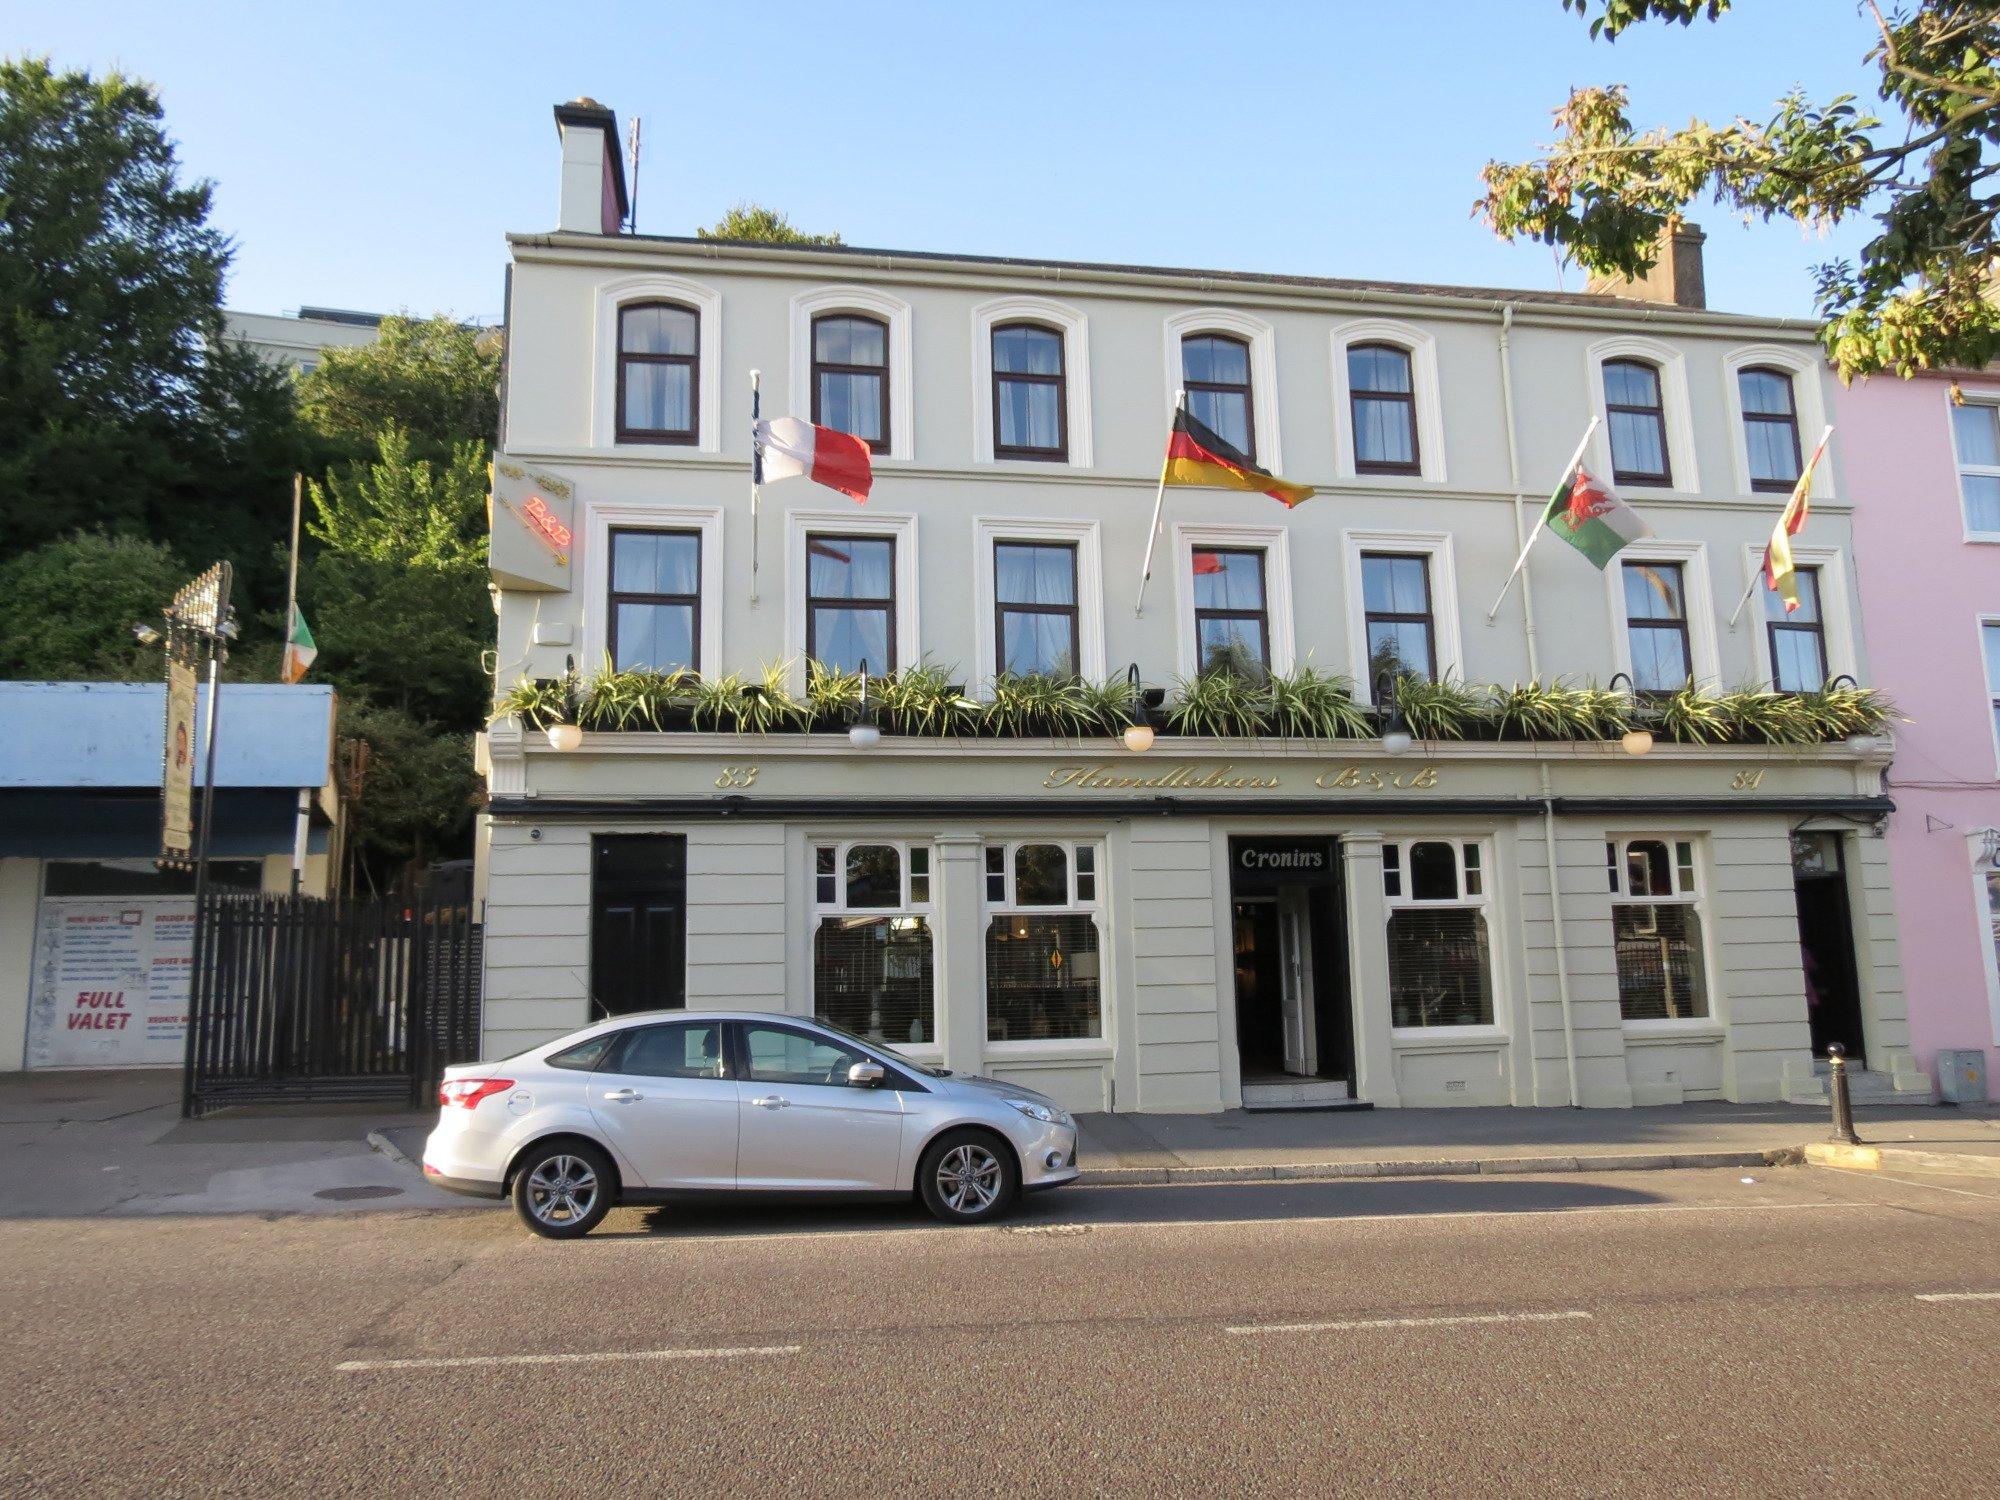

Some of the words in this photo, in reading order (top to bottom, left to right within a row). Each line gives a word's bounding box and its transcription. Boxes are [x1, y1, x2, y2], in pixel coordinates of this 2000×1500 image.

[524, 496, 572, 546] B&B
[714, 767, 758, 788] 83
[1042, 764, 1280, 789] Handlebars
[1241, 849, 1323, 869] Cronin's
[76, 991, 127, 1009] FULL
[67, 1012, 133, 1031] VALET
